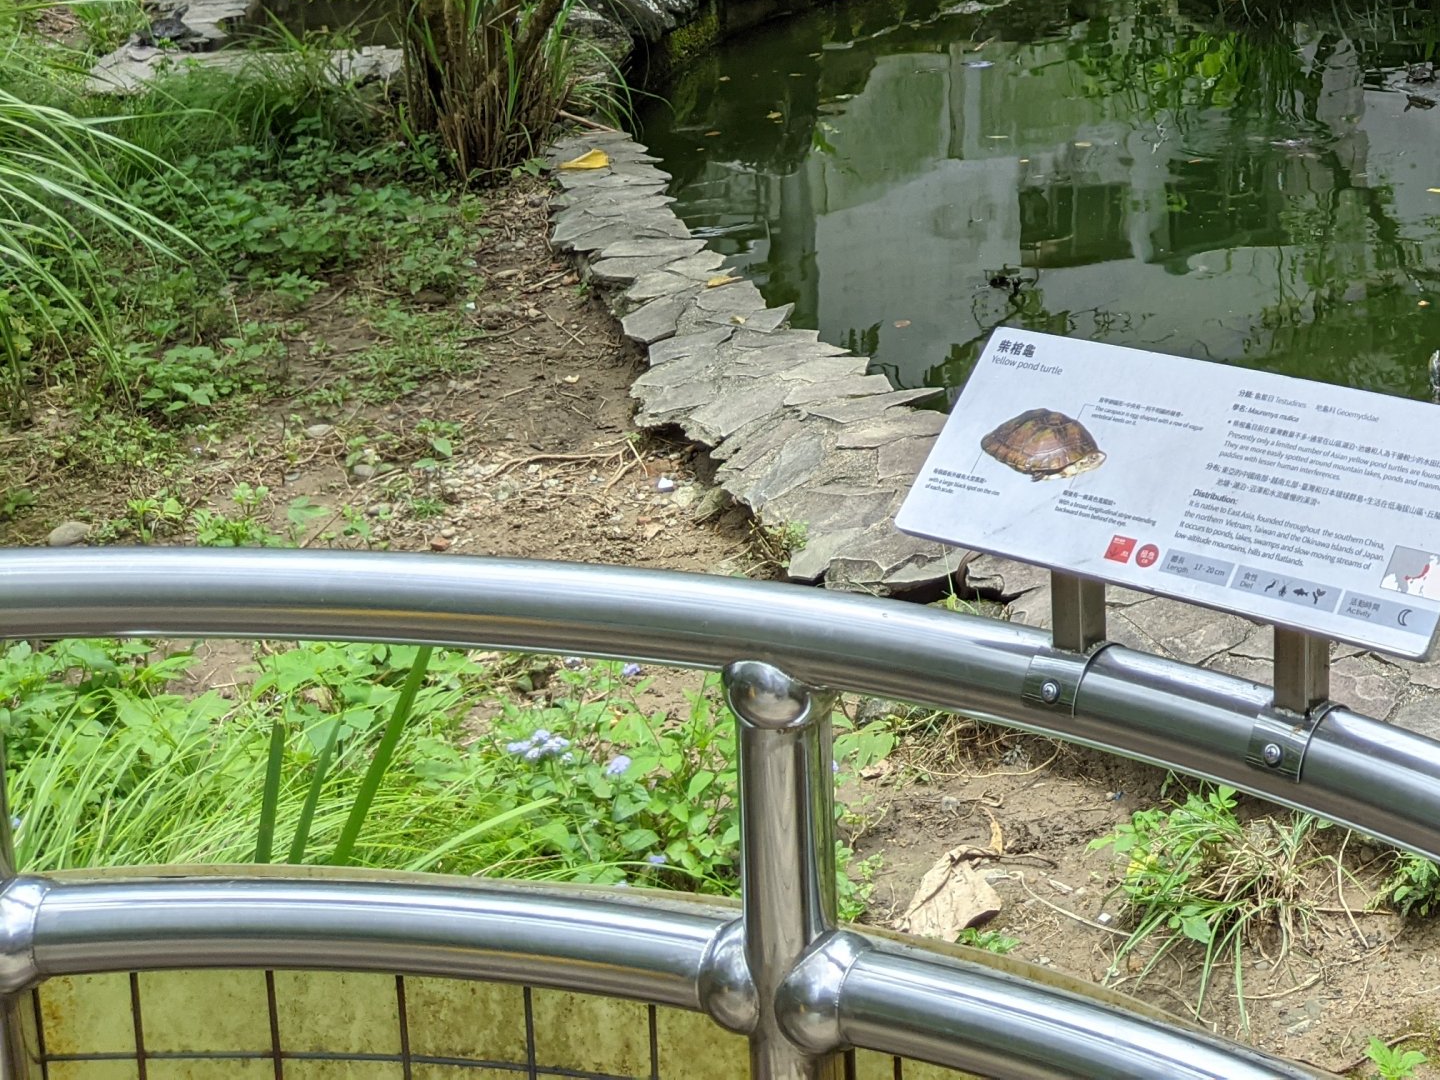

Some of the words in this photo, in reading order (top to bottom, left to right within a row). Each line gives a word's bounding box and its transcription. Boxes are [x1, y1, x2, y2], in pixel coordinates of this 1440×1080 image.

[997, 339, 1036, 358] 柴棺龜
[992, 355, 1017, 366] Yellow
[1016, 361, 1040, 370] pond
[1040, 364, 1063, 375] turtle
[1276, 396, 1306, 408] Testudines
[1248, 407, 1278, 418] Mauremys
[1336, 408, 1379, 422] Geoemydidae
[1224, 440, 1238, 450] They
[1266, 450, 1284, 459] easily
[1285, 454, 1309, 463] spotted
[1309, 459, 1332, 468] around
[1332, 464, 1363, 474] mountain
[1364, 469, 1381, 479] lakes,
[1382, 474, 1403, 483] ponds
[1227, 430, 1256, 443] Presently
[1256, 437, 1270, 446] only
[1275, 440, 1298, 450] limited
[1298, 446, 1323, 455] number
[1330, 452, 1348, 460] Asian
[1348, 456, 1369, 465] yellow
[1369, 461, 1388, 469] pond
[1388, 464, 1409, 473] turtles
[1421, 470, 1440, 480] found
[1218, 451, 1243, 460] paddies
[1258, 458, 1276, 466] lesser
[1277, 462, 1299, 471] human
[1299, 467, 1340, 480] interferences.
[1193, 489, 1238, 505] Distribution:
[1184, 510, 1195, 518] the
[1195, 514, 1223, 524] northern
[1225, 519, 1252, 532] Vietnam,
[1254, 525, 1276, 536] Taiwan
[1290, 534, 1301, 542] the
[1302, 536, 1330, 548] Okinawa
[1331, 543, 1354, 554] Islands
[1362, 550, 1384, 561] Japan.
[1200, 503, 1219, 512] native
[1227, 508, 1241, 517] East
[1240, 511, 1255, 521] Asia,
[1256, 514, 1284, 526] founded
[1284, 521, 1321, 535] throughout
[1334, 533, 1364, 544] southern
[1364, 539, 1384, 551] China,
[1174, 530, 1212, 545] low-altitude
[1212, 540, 1246, 554] mountains,
[1247, 547, 1261, 556] hills
[1261, 552, 1275, 560] and
[1275, 553, 1303, 567] flatlands.
[1185, 523, 1205, 532] occurs
[1212, 529, 1233, 540] ponds,
[1235, 533, 1252, 544] lakes,
[1253, 538, 1280, 549] swamps
[1280, 544, 1294, 552] and
[1294, 547, 1336, 564] slow-moving
[1336, 557, 1362, 568] streams
[1166, 563, 1188, 574] Length
[1205, 566, 1215, 574] 20
[1239, 580, 1253, 589] Diet
[1346, 607, 1371, 618] Activity
